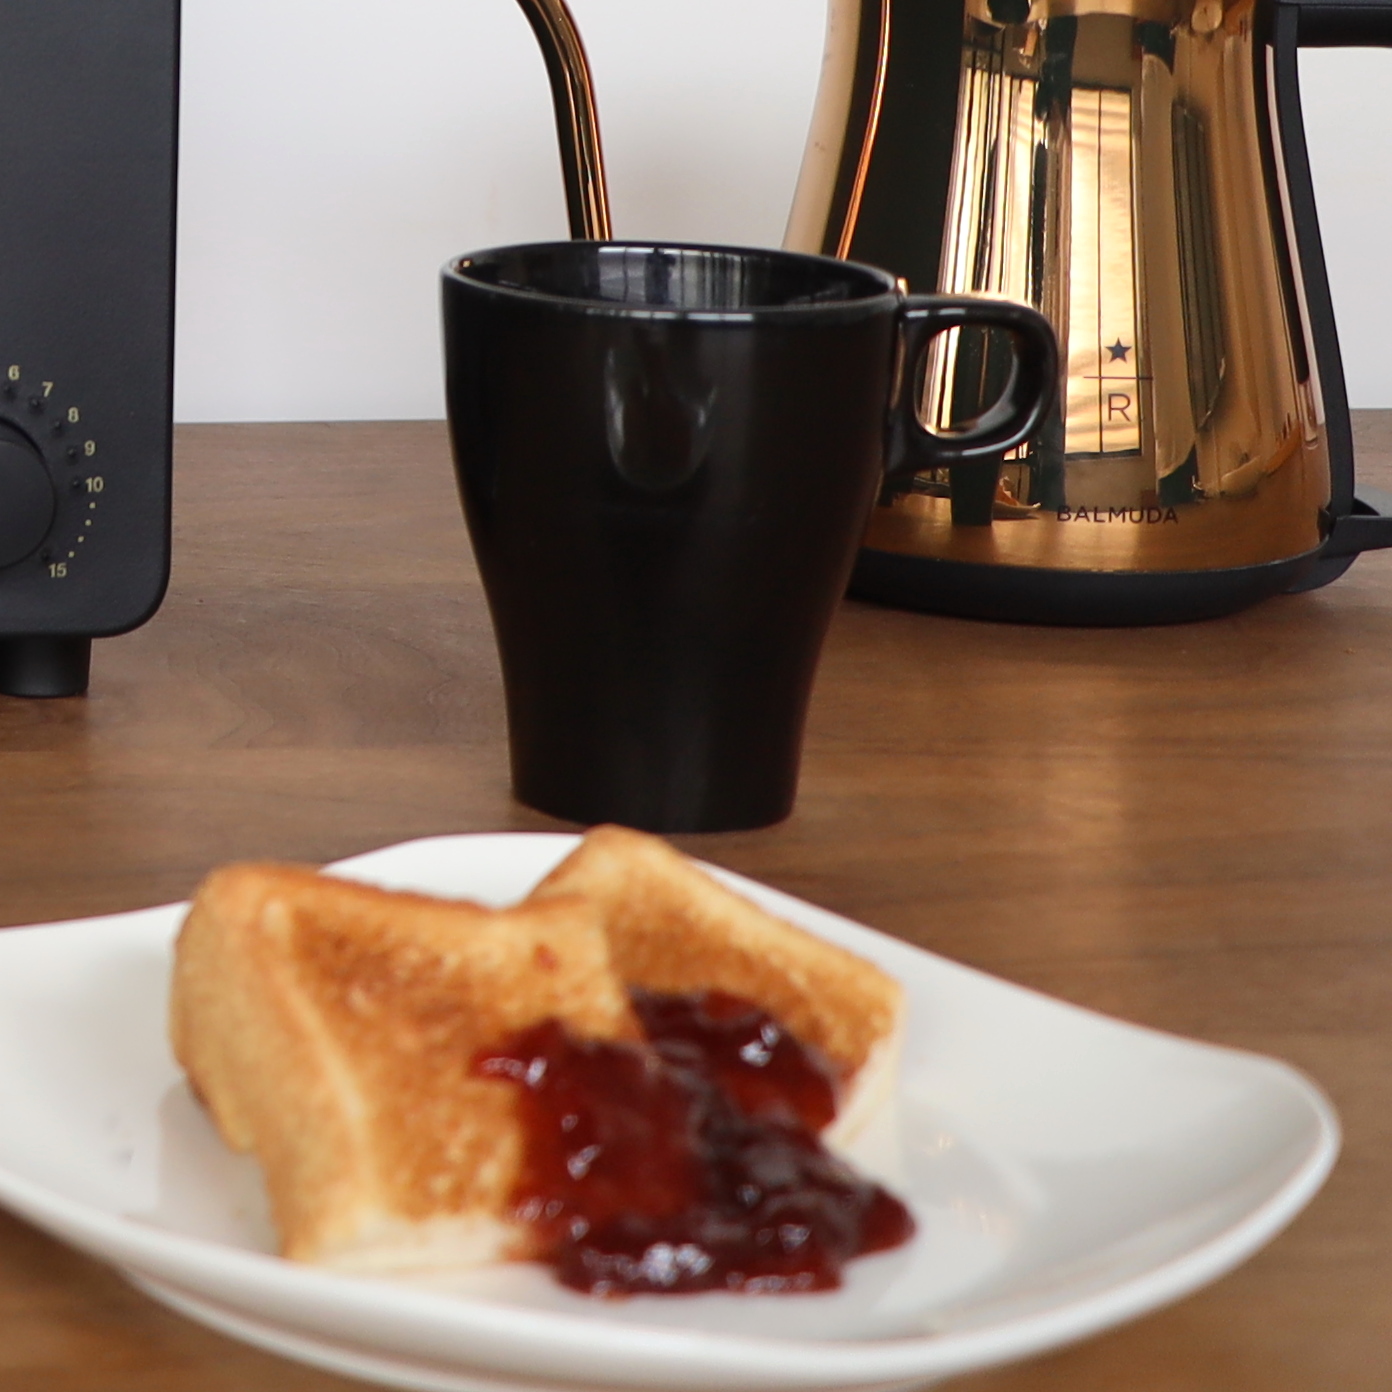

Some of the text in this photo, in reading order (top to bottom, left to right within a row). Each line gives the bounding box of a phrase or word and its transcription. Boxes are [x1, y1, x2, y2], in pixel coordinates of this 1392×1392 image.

[8, 365, 20, 380] 6
[41, 381, 53, 397] 7
[68, 407, 79, 422] 8
[1107, 393, 1131, 422] R
[84, 440, 96, 456] 9
[85, 476, 104, 492] 10
[1056, 505, 1179, 524] BALMUDA
[48, 563, 67, 578] 15
